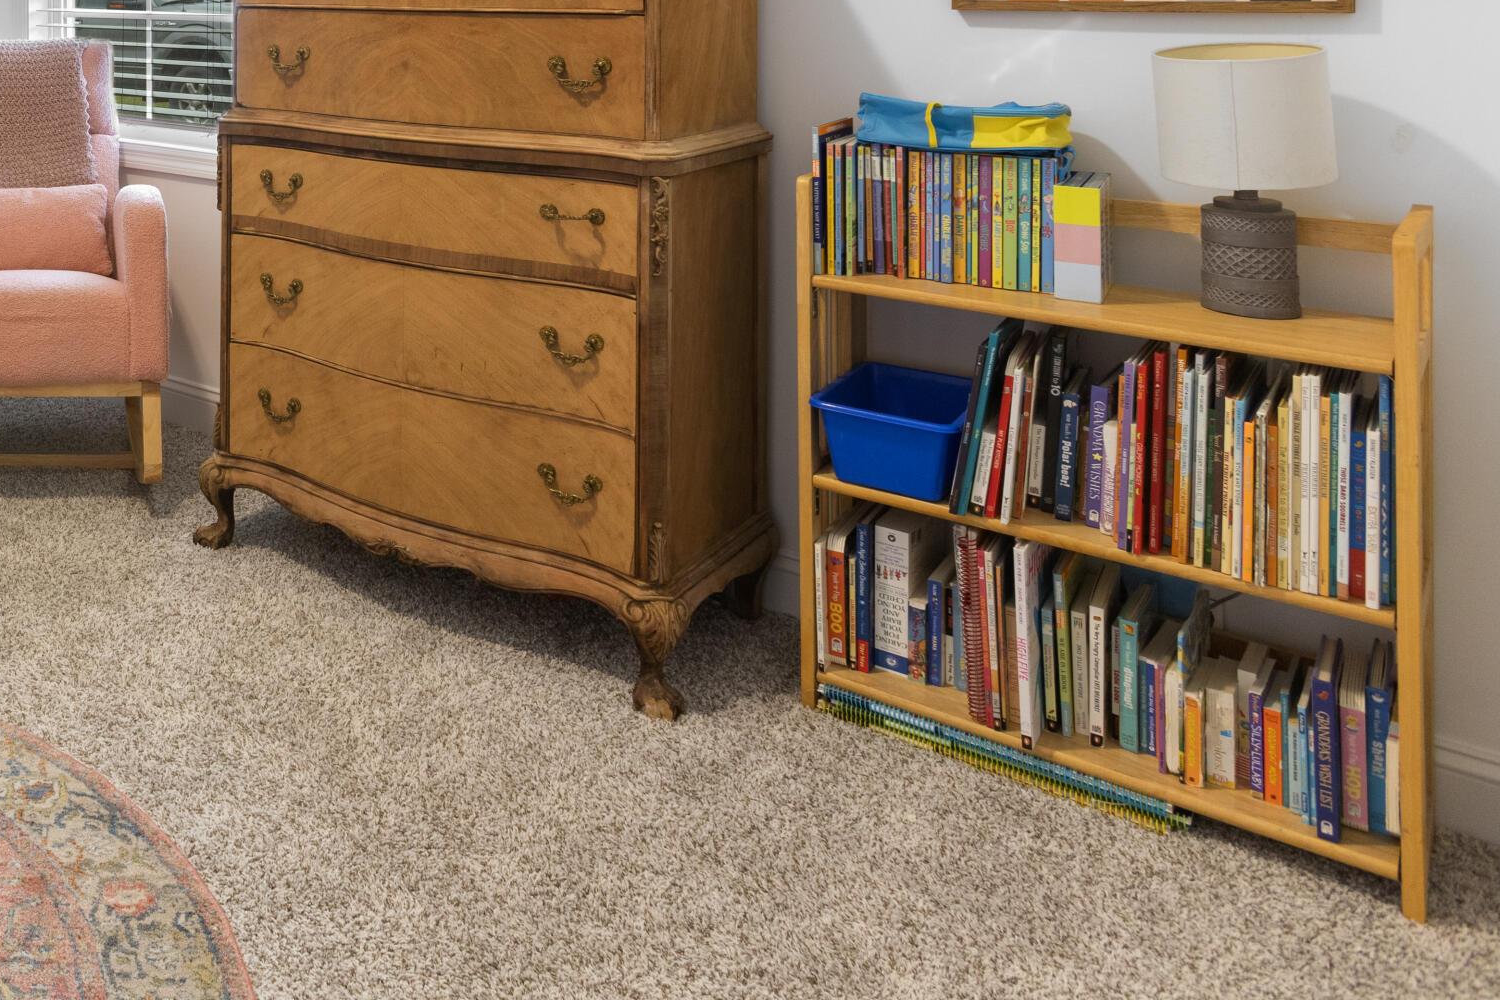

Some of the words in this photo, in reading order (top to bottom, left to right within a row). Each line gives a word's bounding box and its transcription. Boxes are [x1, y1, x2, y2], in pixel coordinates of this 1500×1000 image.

[1050, 384, 1061, 396] 10
[1092, 400, 1107, 451] GRANDMA
[994, 450, 1002, 469] KITCHEN
[1089, 462, 1102, 500] WISHES
[877, 592, 905, 604] CHILD
[877, 599, 907, 613] YOUNG
[829, 601, 843, 633] BOO
[881, 614, 903, 625] BABY
[882, 608, 900, 618] AND
[880, 621, 903, 633] YOUR
[884, 629, 900, 640] FOR
[875, 634, 908, 649] CARING
[1018, 637, 1027, 662] HIGH
[1019, 663, 1028, 681] FIVE
[1251, 724, 1262, 748] SILLY
[1316, 710, 1332, 761] GRANDPA'S
[1251, 751, 1262, 789] LULLABY
[1371, 740, 1385, 779] shark!
[1319, 763, 1332, 789] WISH
[1345, 765, 1361, 800] HOP
[1319, 790, 1333, 811] LIST
